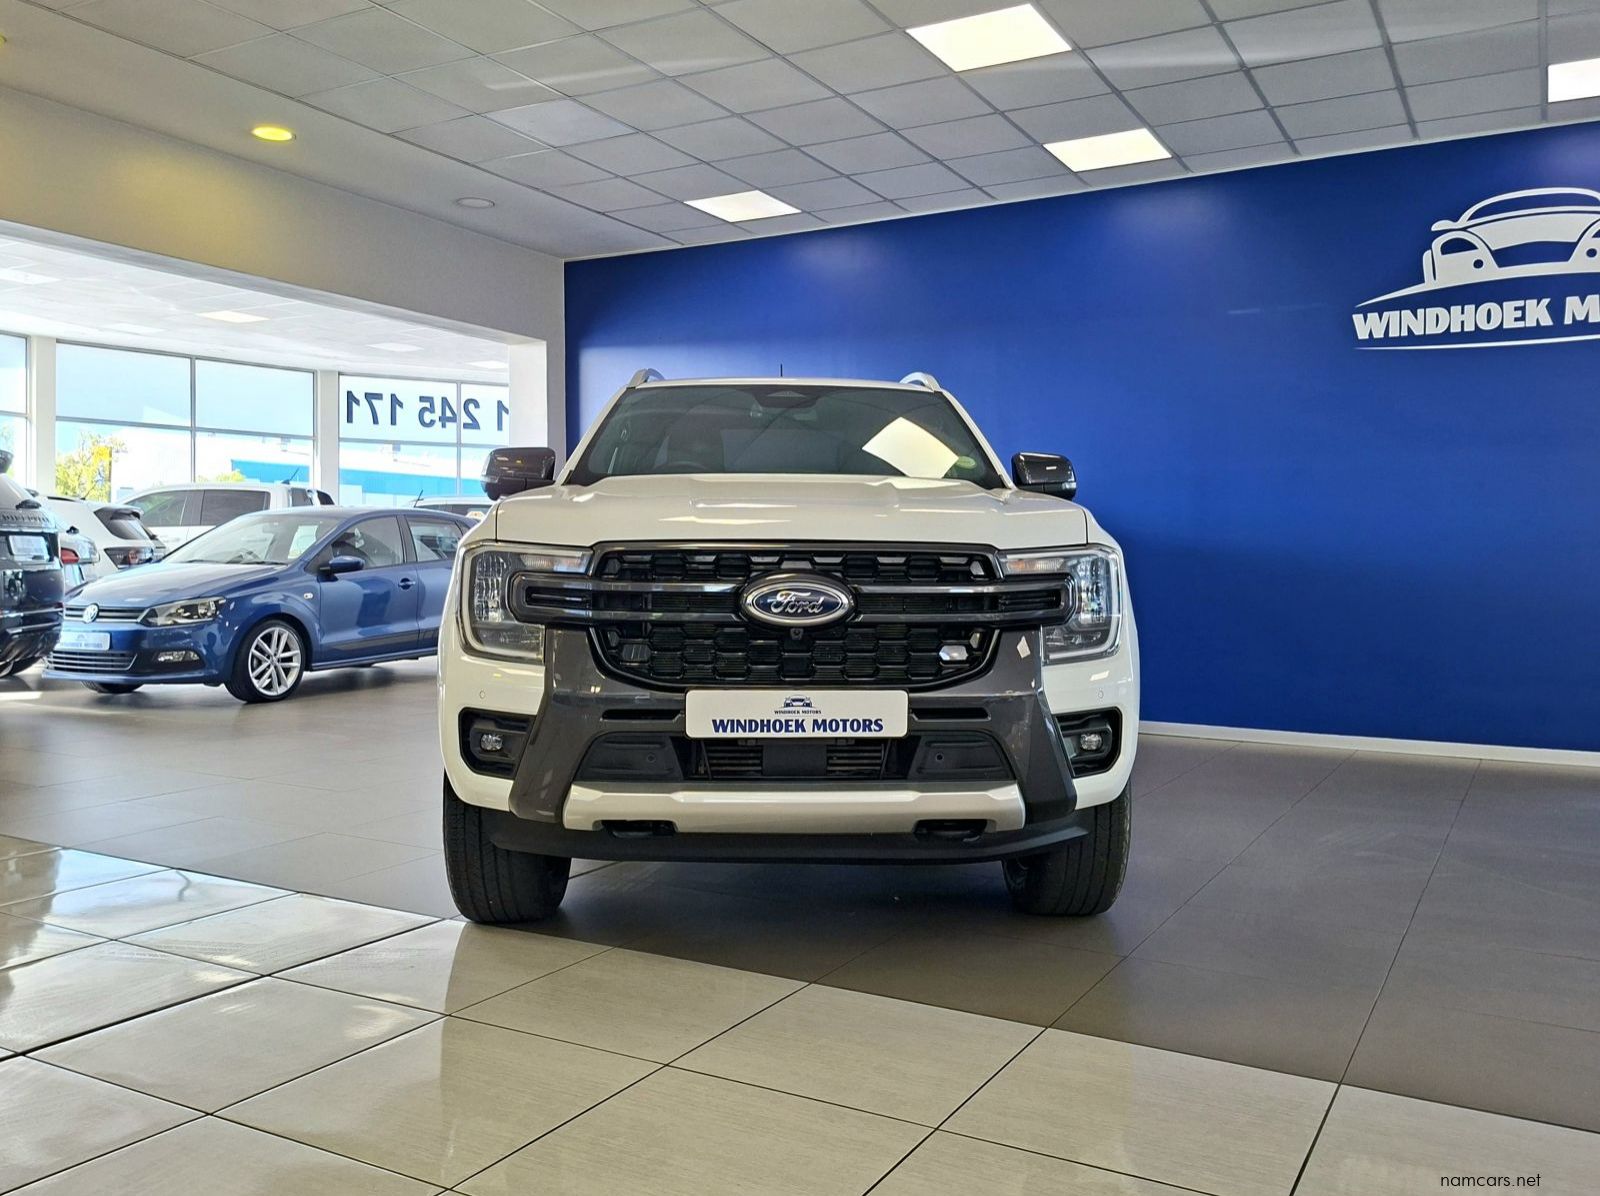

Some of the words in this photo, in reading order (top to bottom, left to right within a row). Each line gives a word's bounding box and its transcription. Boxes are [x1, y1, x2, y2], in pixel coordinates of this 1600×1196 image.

[1352, 298, 1553, 340] WINDHOEK
[767, 590, 825, 614] Ford
[712, 719, 806, 733] WINDHOEK
[811, 718, 884, 732] MOTORS
